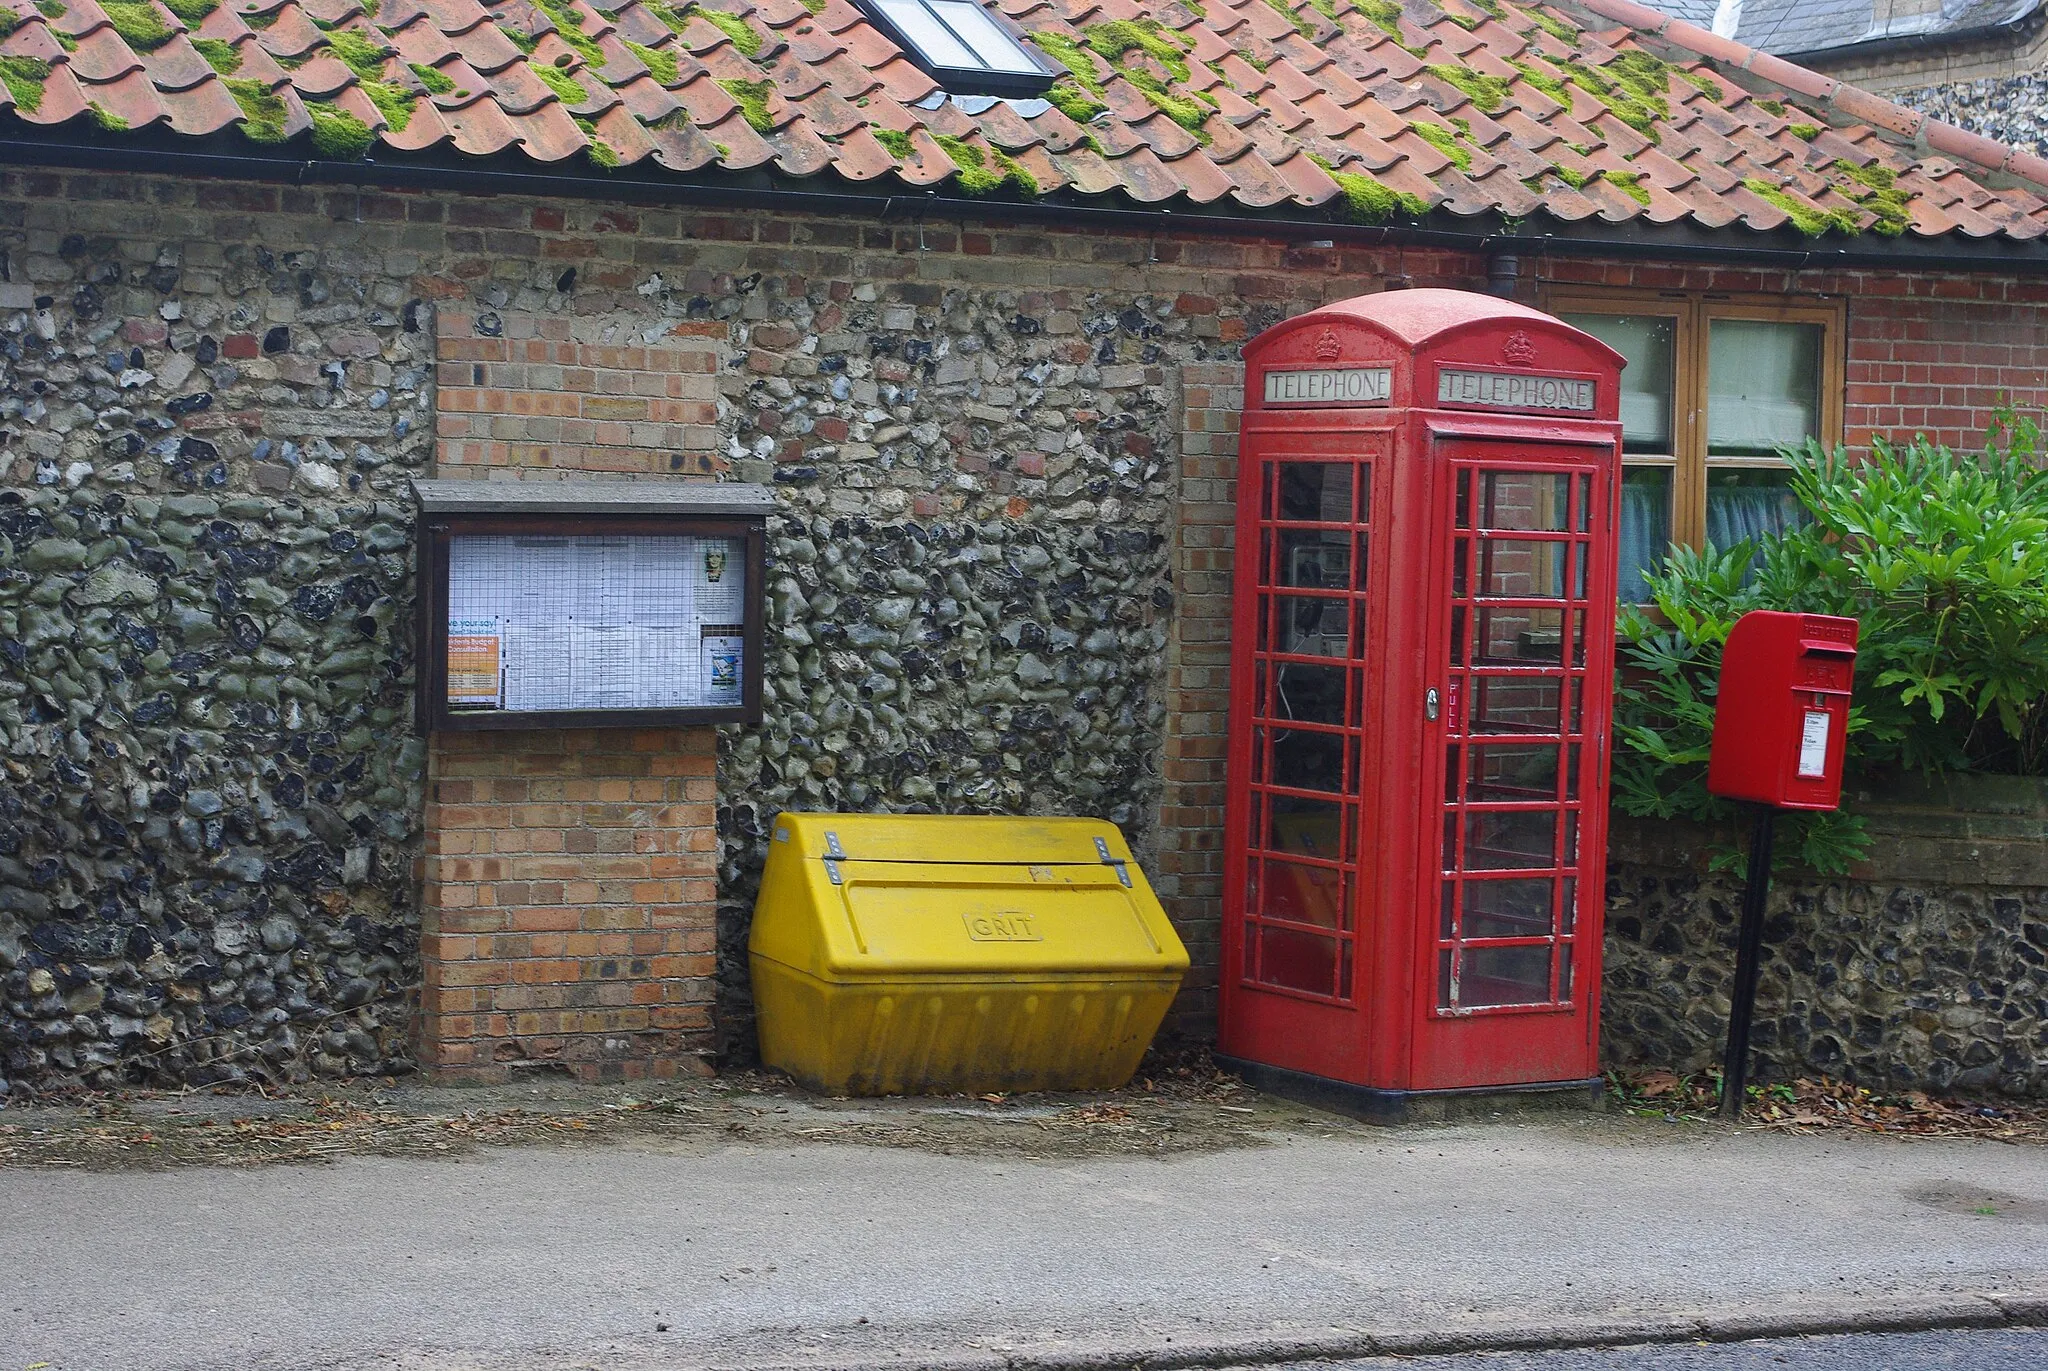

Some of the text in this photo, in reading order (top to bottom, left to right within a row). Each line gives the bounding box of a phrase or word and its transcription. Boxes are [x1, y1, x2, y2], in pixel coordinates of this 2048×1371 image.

[1271, 372, 1388, 398] TELEPHONE
[1443, 372, 1589, 407] TELEPHONE
[1448, 684, 1458, 728] PULL
[972, 917, 1033, 936] GRIT
